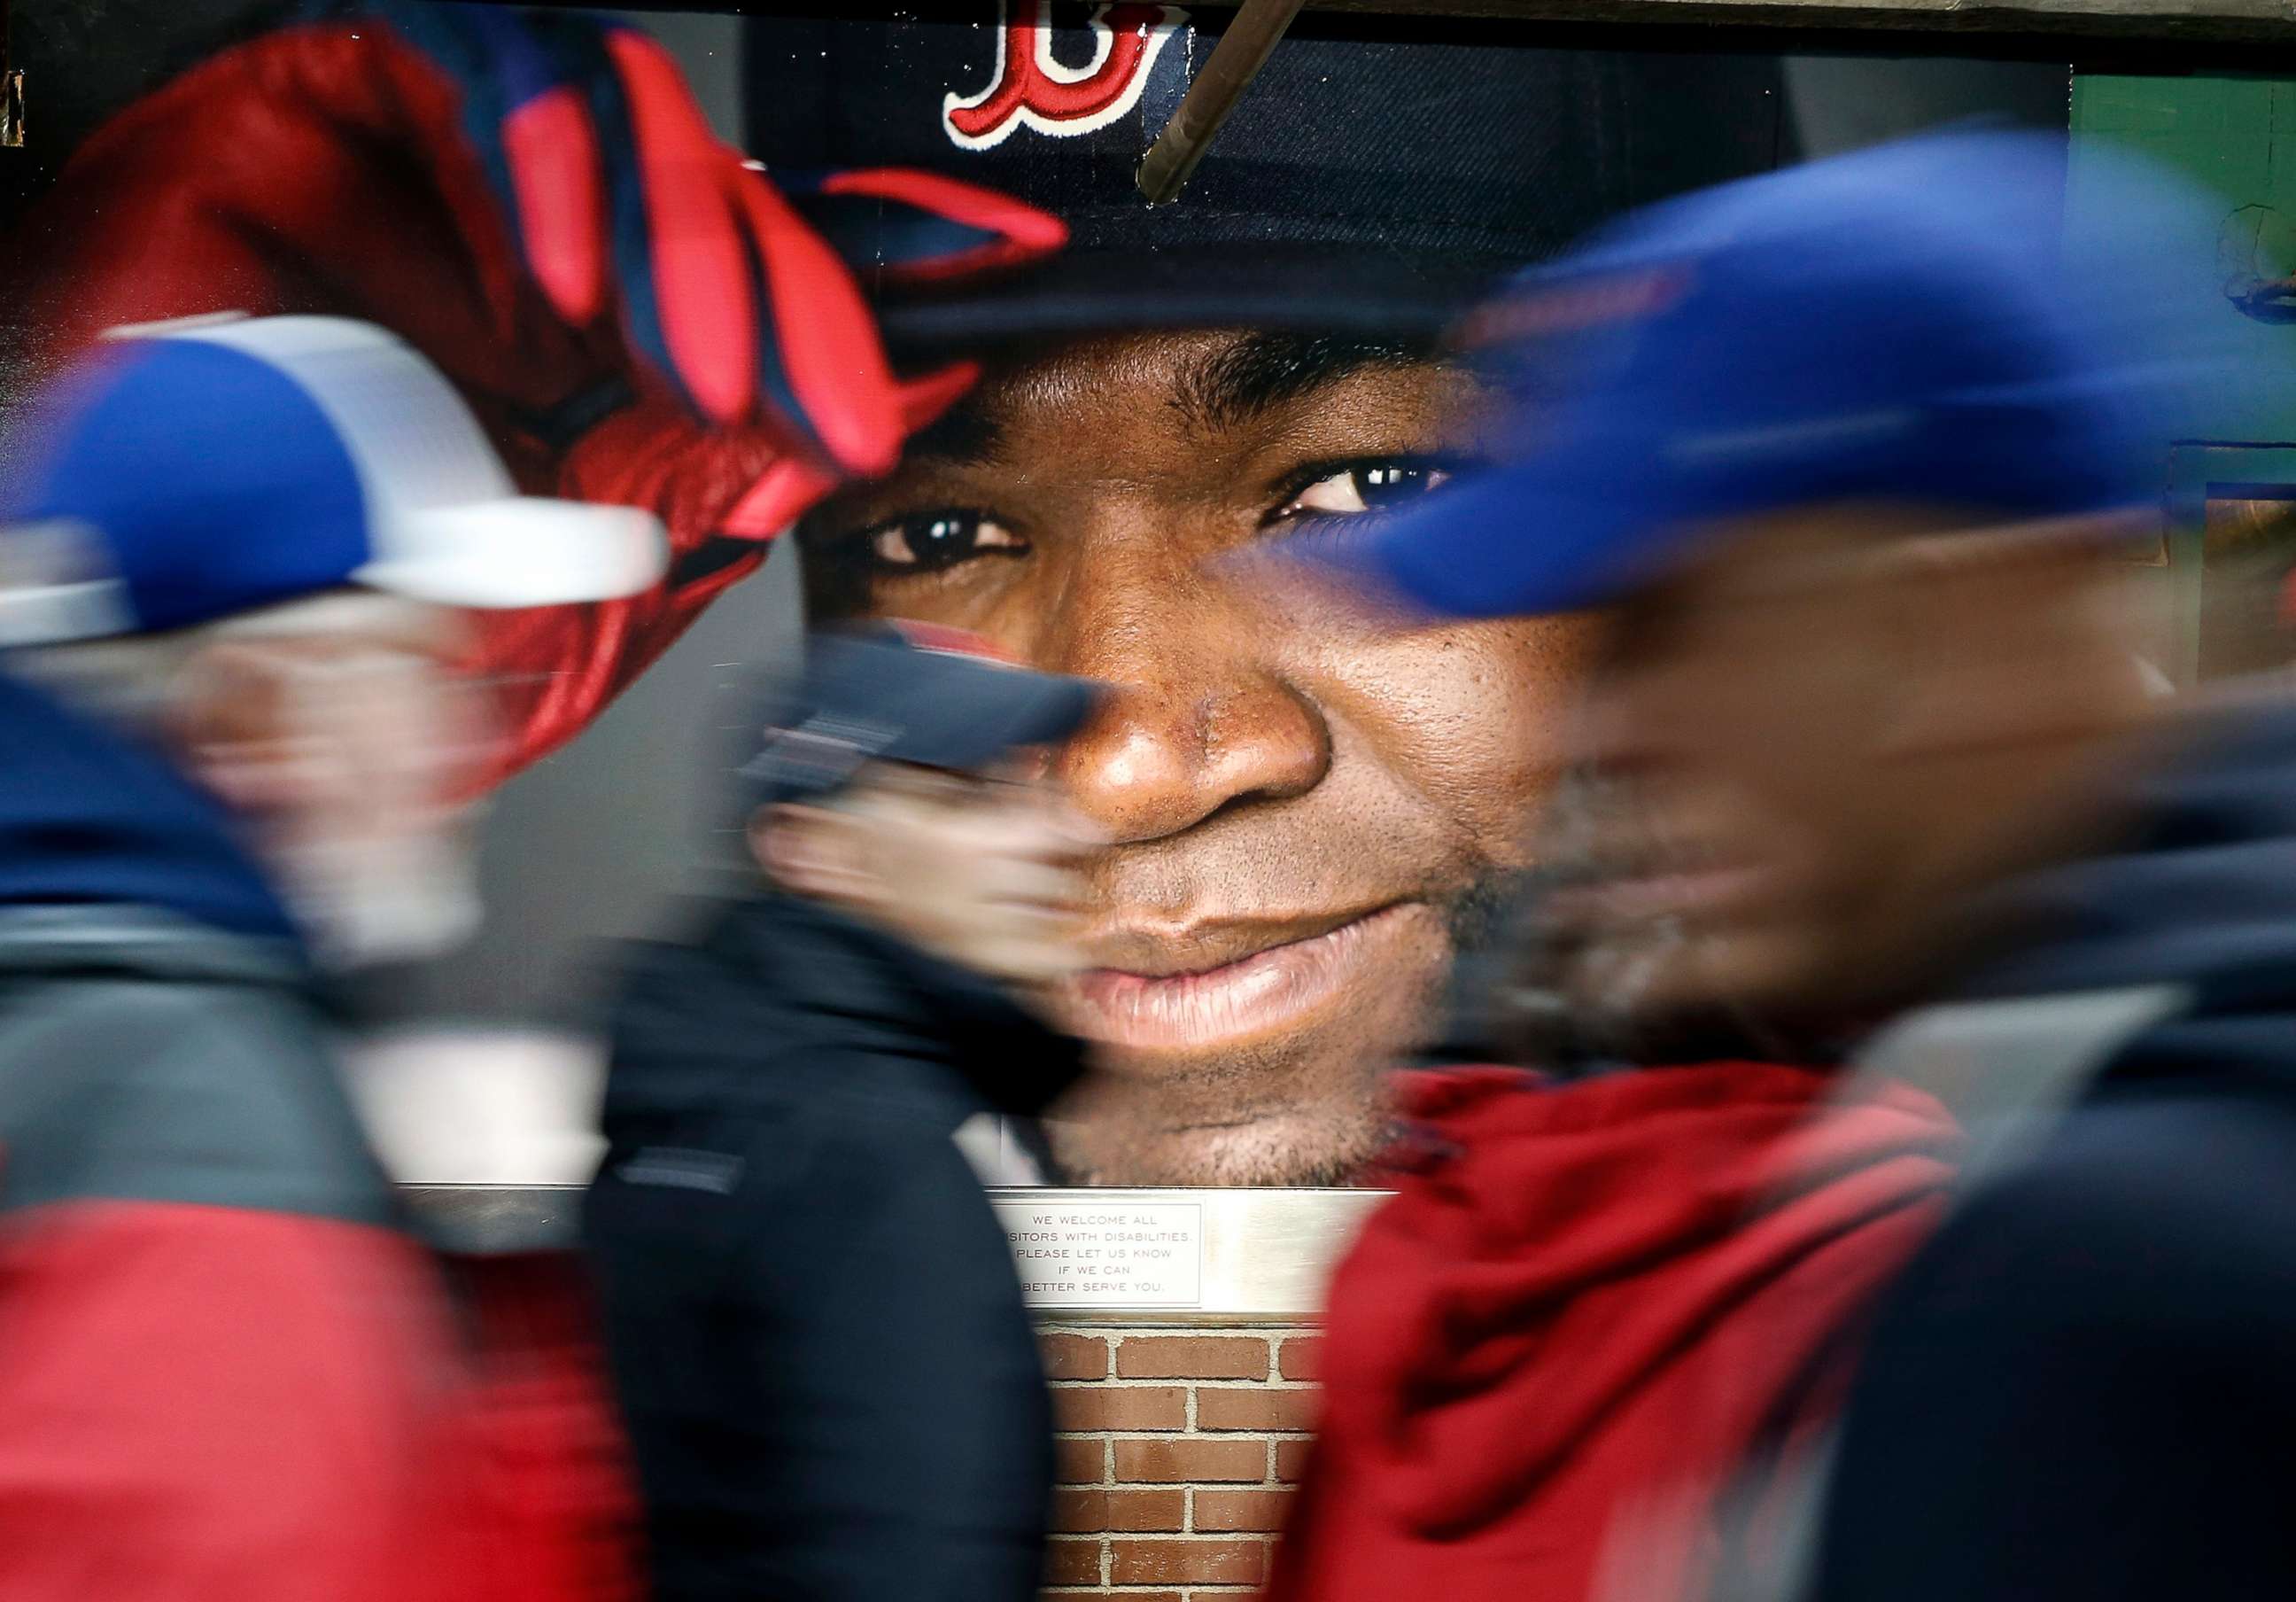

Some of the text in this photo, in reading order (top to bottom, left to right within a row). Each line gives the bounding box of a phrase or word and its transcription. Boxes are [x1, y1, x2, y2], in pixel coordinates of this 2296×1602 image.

[1033, 1216, 1158, 1225] WE WELCOME ALL
[1005, 1233, 1193, 1241] ISITORS WITH DISABILITIES.
[1016, 1249, 1171, 1258] PLEASE LET US KNOW
[1059, 1266, 1130, 1275] IF WE CAN
[1022, 1282, 1075, 1292] BETTER
[1082, 1282, 1127, 1292] SERVE
